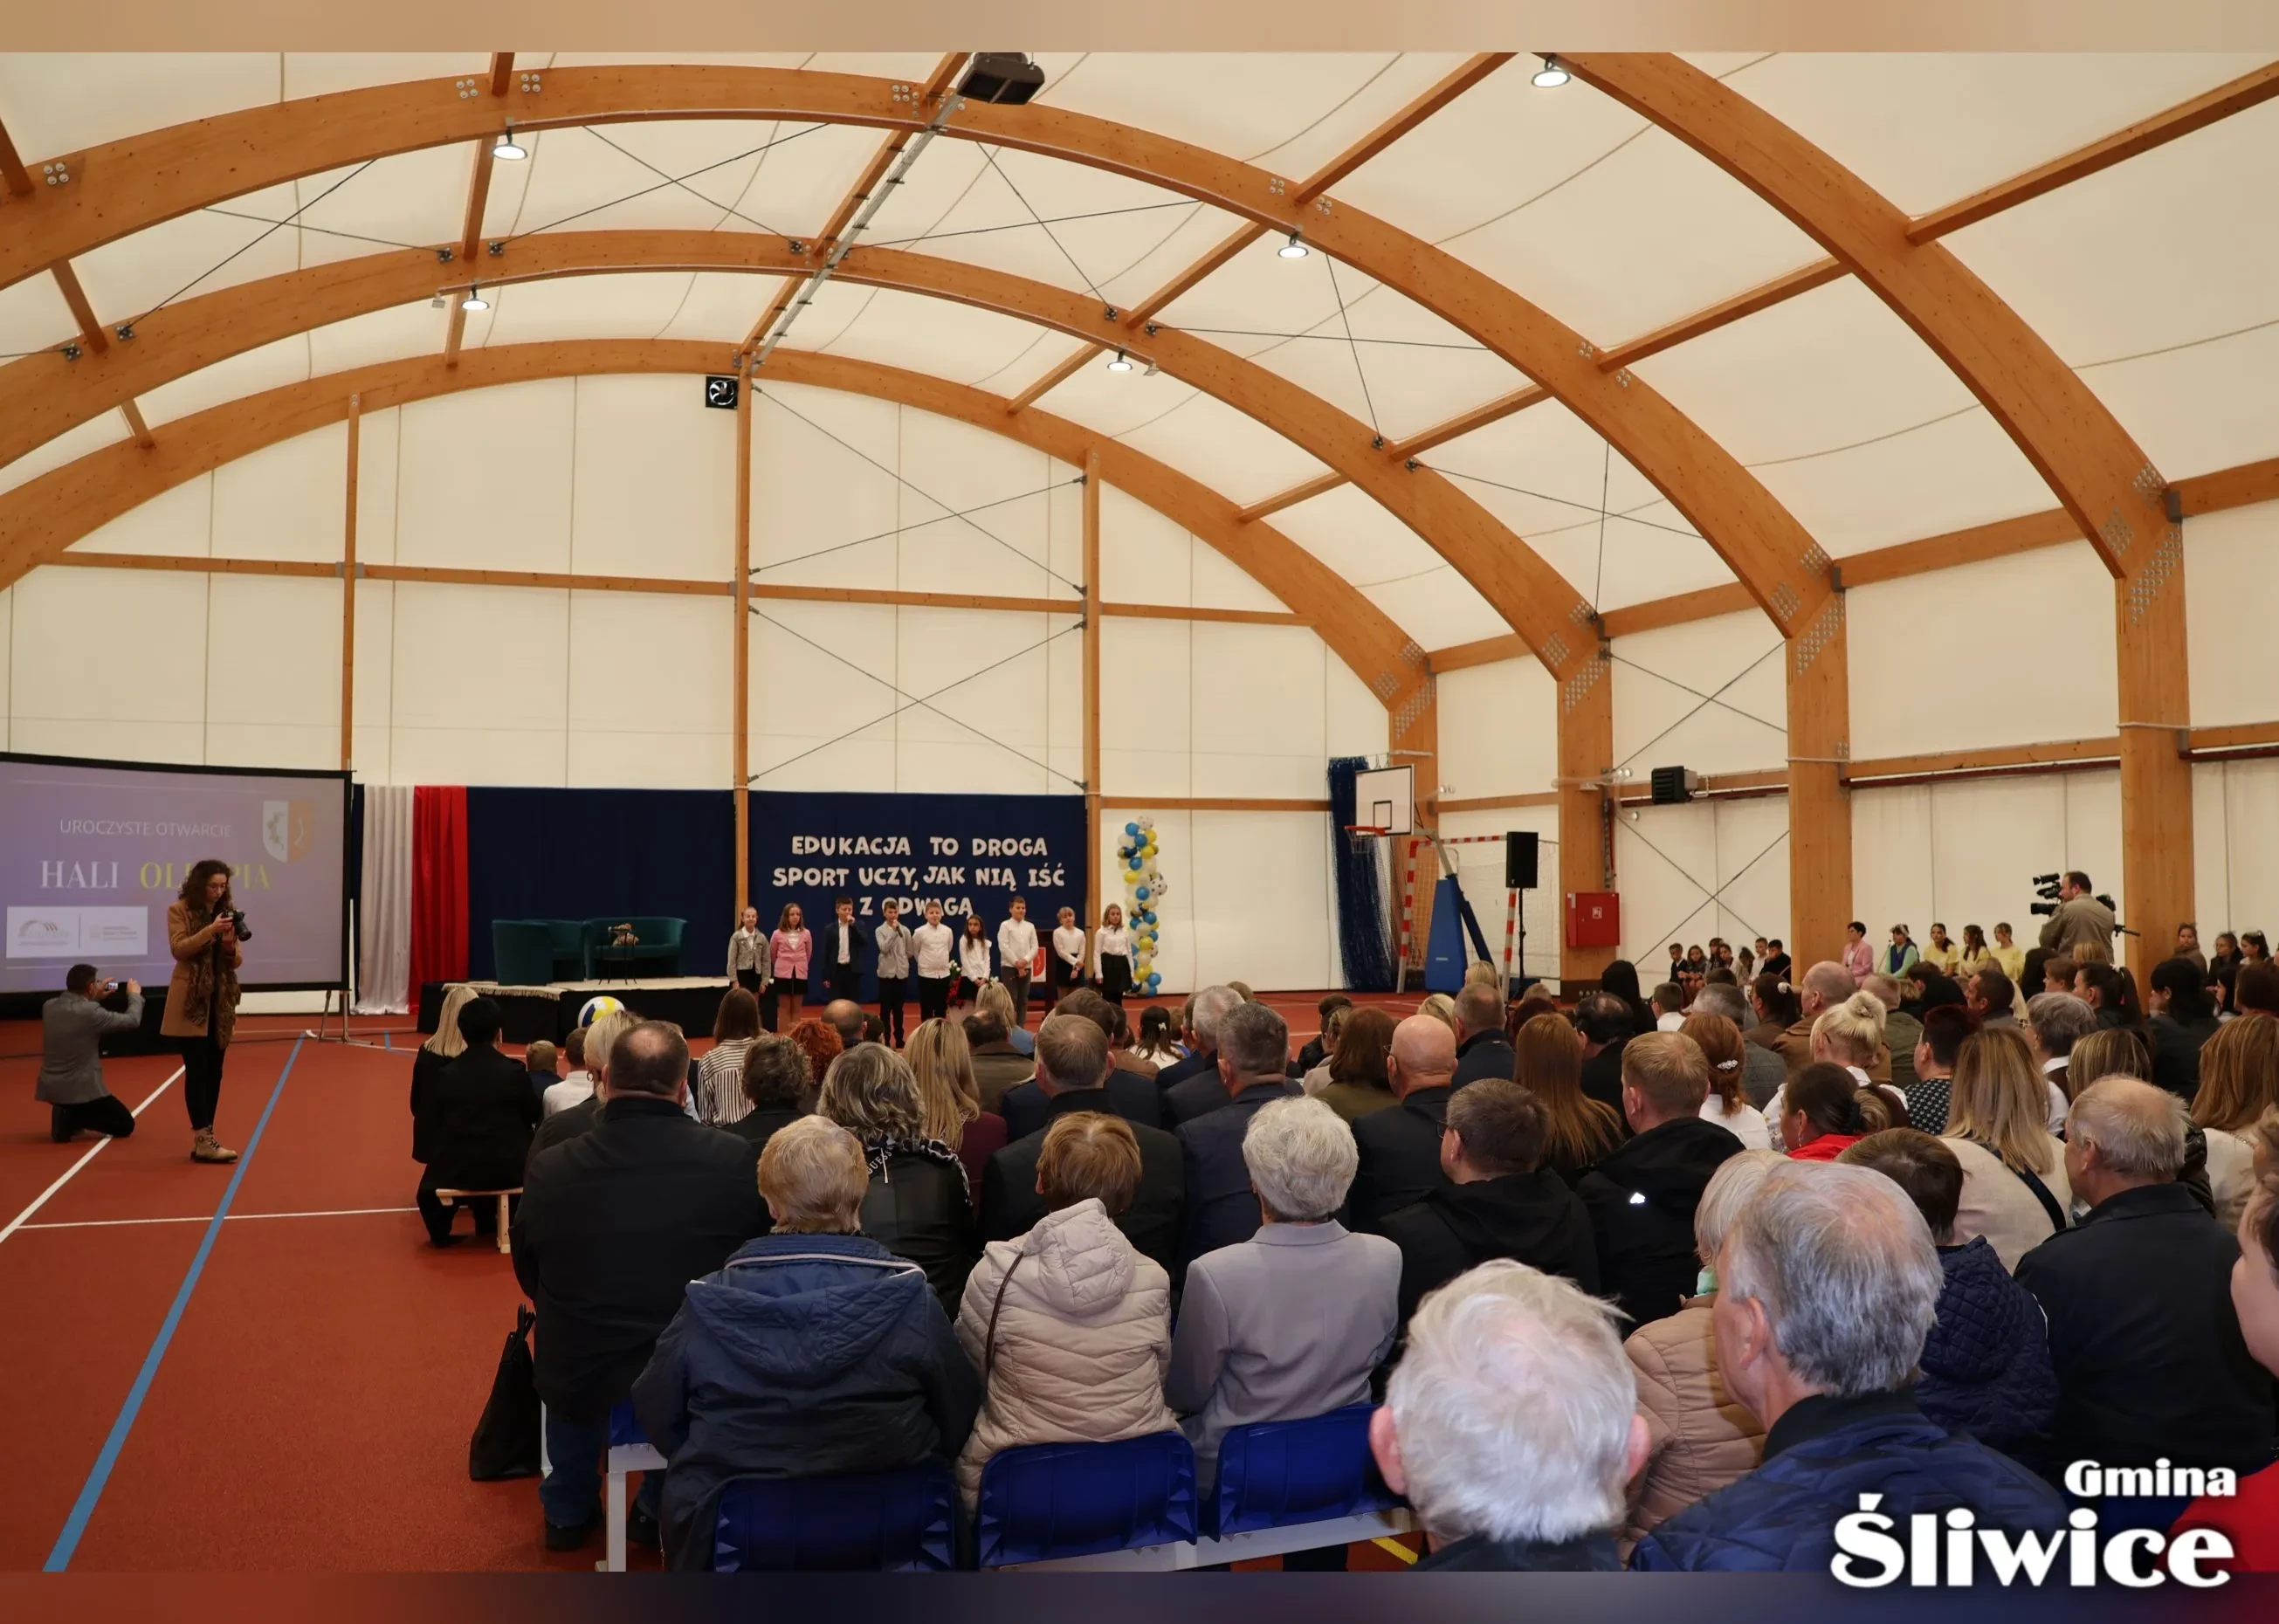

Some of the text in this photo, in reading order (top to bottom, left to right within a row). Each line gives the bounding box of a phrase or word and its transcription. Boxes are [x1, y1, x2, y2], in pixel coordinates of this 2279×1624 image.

[60, 818, 231, 838] UROCZYSTE OTWARCIE
[791, 836, 1048, 857] EDUKACJA TO DROGA
[40, 860, 271, 890] HALI OLIA
[772, 863, 1064, 891] SPORT UCZY, JAK NIĄ IŚĆ
[859, 897, 873, 915] Z
